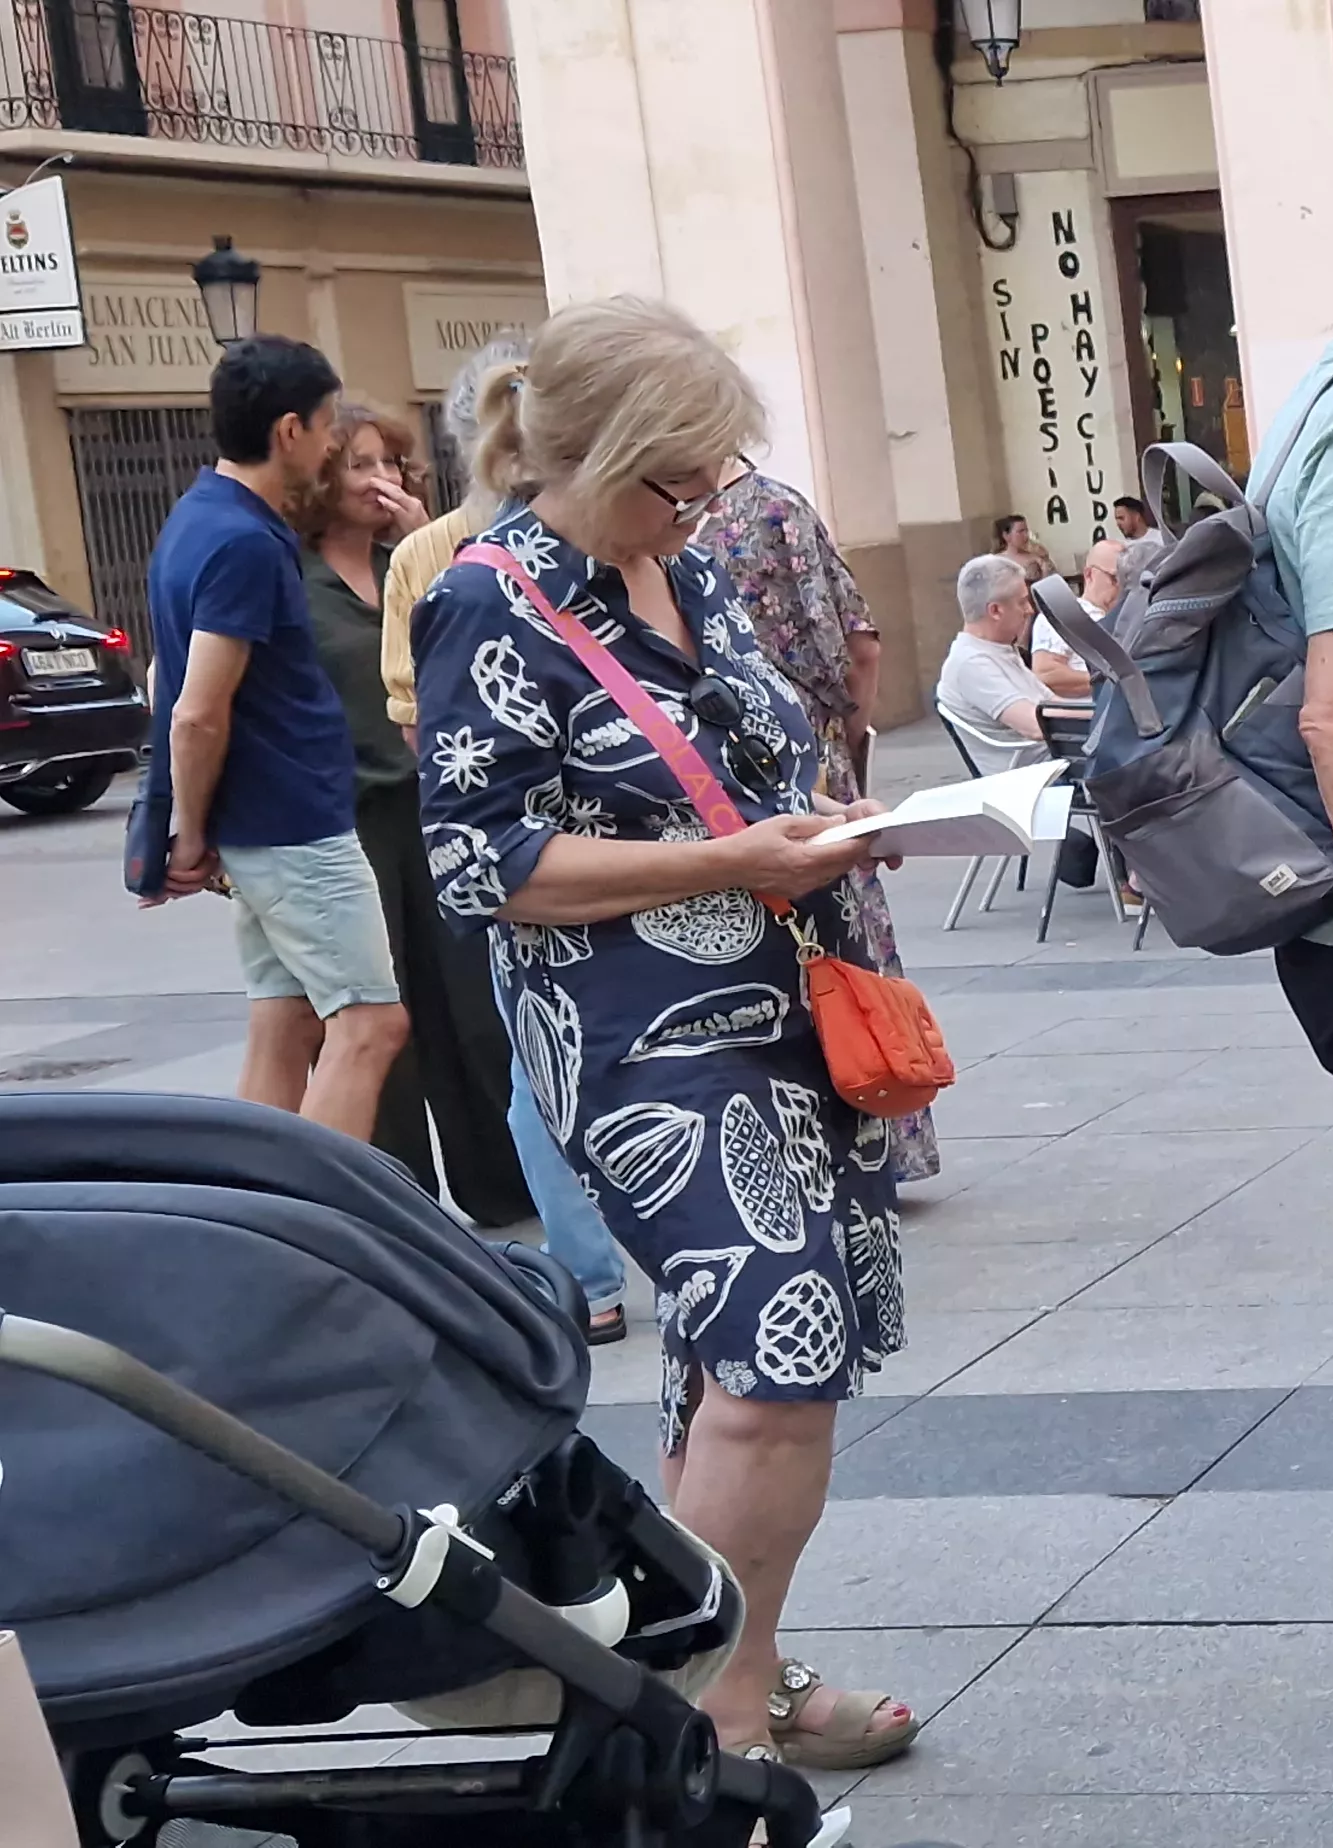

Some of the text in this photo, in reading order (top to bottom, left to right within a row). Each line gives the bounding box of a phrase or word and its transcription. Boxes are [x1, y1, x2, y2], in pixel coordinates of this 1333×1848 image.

[23, 319, 73, 340] Berlin
[992, 278, 1021, 381] SIN
[1052, 208, 1080, 279] NO
[1070, 290, 1099, 398] HAY
[148, 334, 212, 366] JUAN
